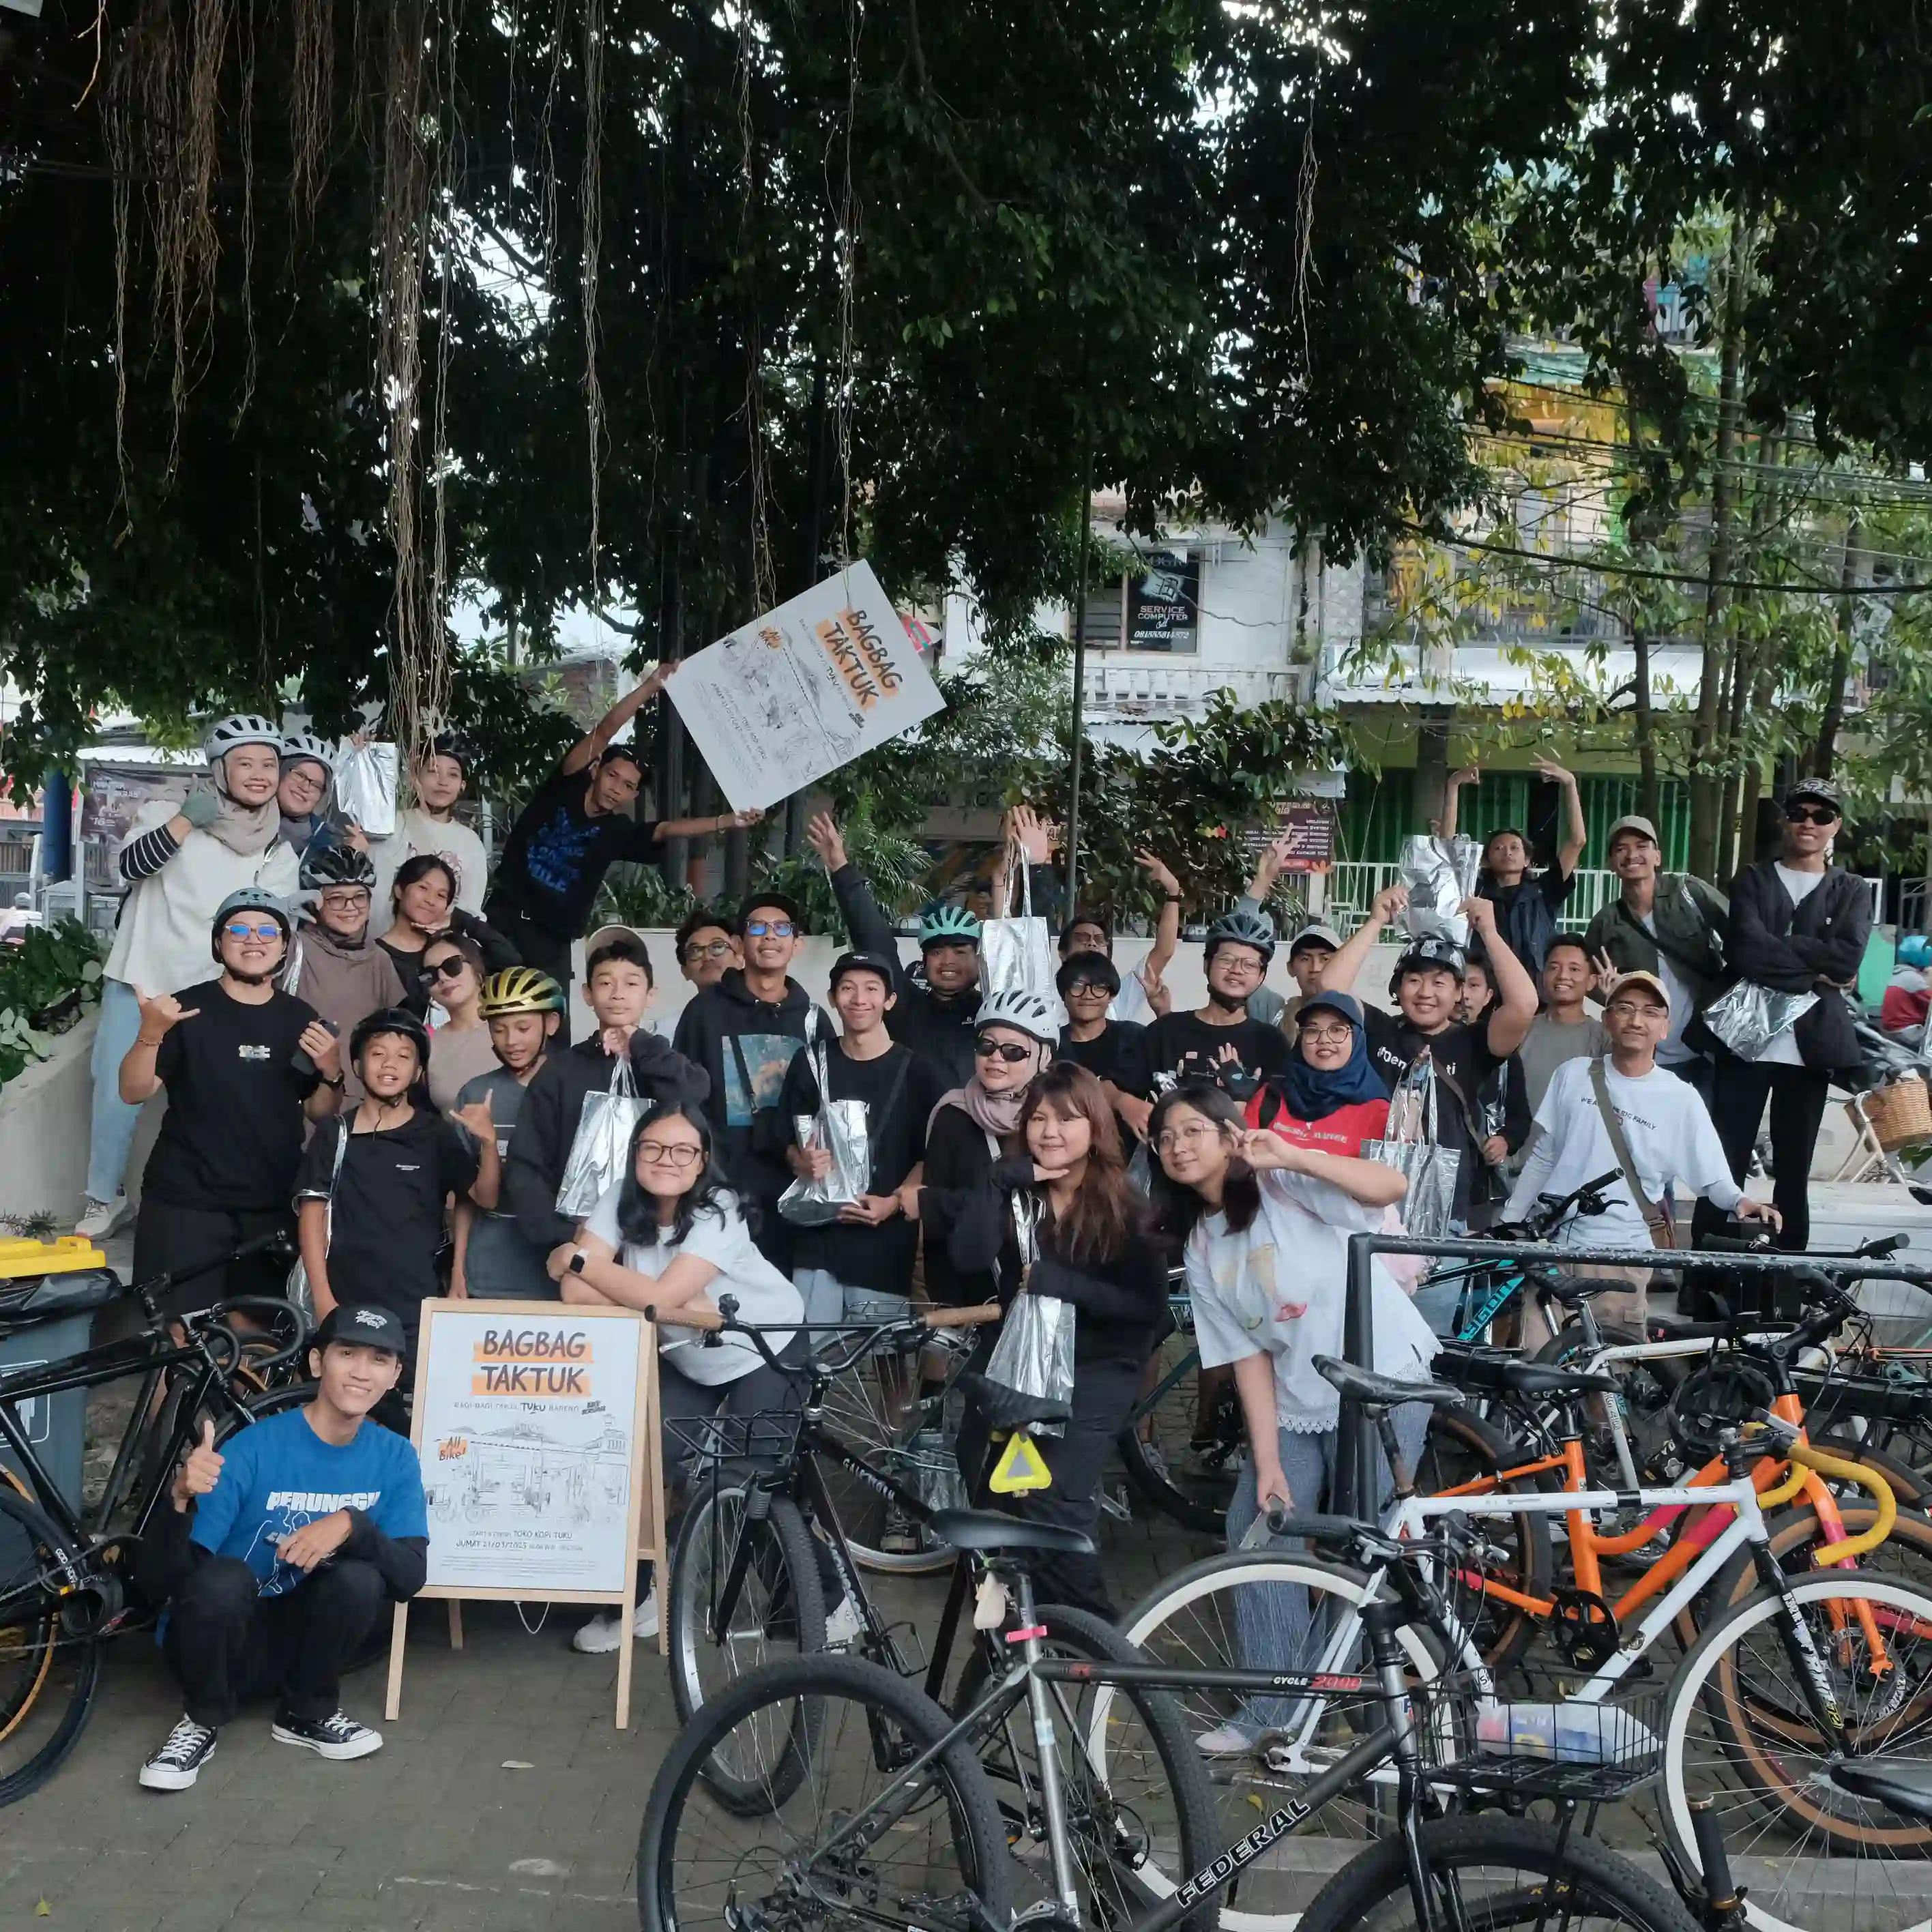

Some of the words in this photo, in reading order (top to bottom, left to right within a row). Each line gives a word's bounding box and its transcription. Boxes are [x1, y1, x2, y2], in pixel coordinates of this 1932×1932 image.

[847, 609, 903, 695] BAGBAG
[824, 621, 879, 706] TAKTUK
[1633, 1115, 1656, 1130] FAMILY
[483, 1329, 586, 1358] BAGBAG
[480, 1364, 585, 1394] TAKTUK
[521, 1403, 546, 1413] TUKU
[445, 1435, 461, 1448] All
[439, 1448, 466, 1461] Bike!
[513, 1530, 532, 1538] TOKO
[534, 1530, 551, 1538] KOPI
[553, 1531, 572, 1539] TUKU
[456, 1538, 480, 1548] JUMAT
[1272, 1675, 1308, 1686] CYCLE
[1176, 1797, 1311, 1909] FEDERAL
